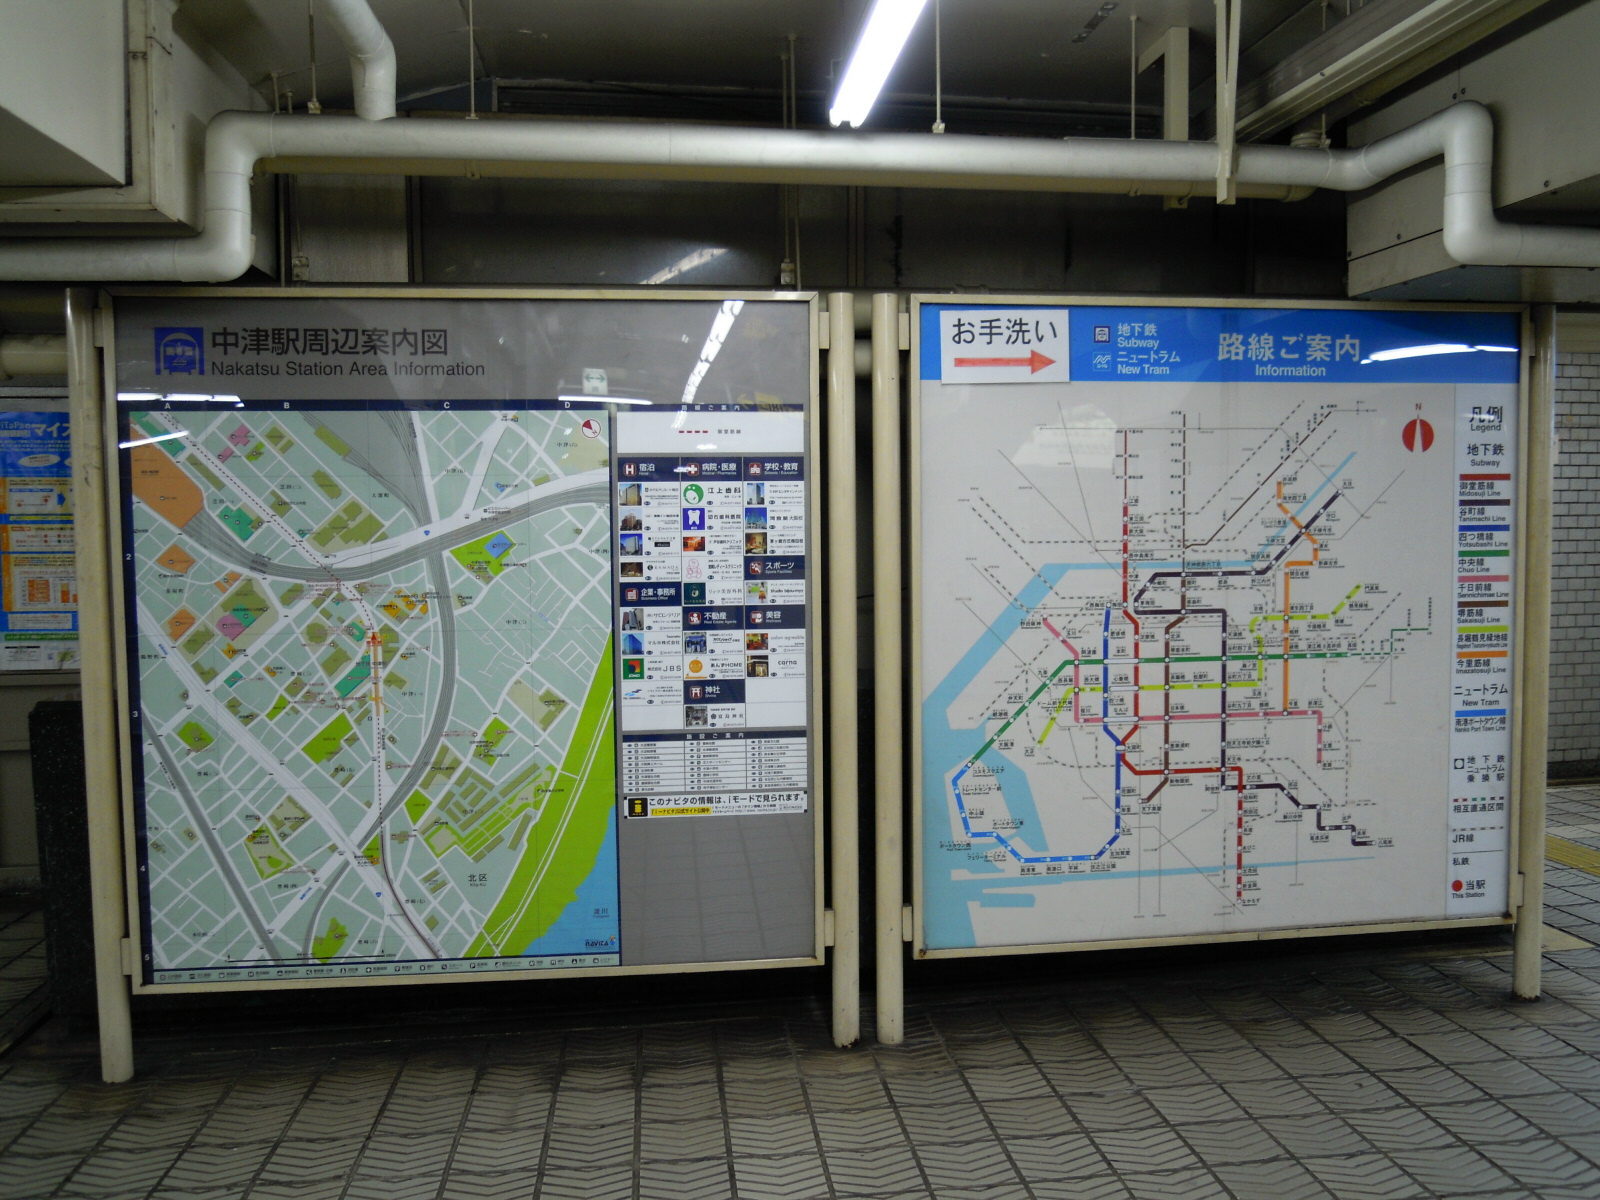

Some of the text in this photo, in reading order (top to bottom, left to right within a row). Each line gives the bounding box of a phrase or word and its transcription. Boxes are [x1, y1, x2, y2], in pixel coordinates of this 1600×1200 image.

[951, 318, 1058, 346] お手洗い
[1118, 322, 1158, 337] 地下鉄
[210, 327, 448, 356] 中津駅周辺案内図
[1118, 338, 1160, 350] Subway
[1218, 333, 1361, 362] 路線ご案内
[1118, 350, 1180, 364] ニュートラム
[210, 360, 486, 376] Nakatsu Station Area Information
[1118, 364, 1170, 374] New Tram
[1255, 364, 1326, 376] Information
[1415, 402, 1422, 410] N
[1468, 406, 1503, 424] 凡例
[1470, 424, 1502, 432] Legend
[1467, 444, 1504, 456] 地下鉄
[639, 463, 655, 472] 宿泊
[702, 463, 737, 471] 病院・医療
[764, 462, 799, 471] 学校・教育
[1470, 460, 1500, 468] Subway
[1459, 482, 1494, 490] 御堂筋線
[1459, 507, 1485, 516] 谷町線
[1459, 533, 1494, 541] 四つ橋線
[126, 553, 132, 561] 2
[1458, 558, 1484, 567] 中央線
[641, 588, 676, 596] 企業・事務所
[1458, 583, 1492, 592] 千日前線
[766, 611, 781, 619] 美容
[1457, 609, 1483, 617] 堺筋線
[1457, 659, 1491, 668] 今里筋線
[1454, 683, 1508, 696] ニュートラム
[1456, 717, 1506, 727] 南港ポートタウン線
[1467, 764, 1505, 773] ニュートラム
[1453, 803, 1504, 813] 相互直通区間
[1452, 834, 1474, 843] JR線
[1452, 857, 1469, 865] 私鉄
[468, 874, 488, 882] 北区
[1465, 880, 1486, 890] 当駅
